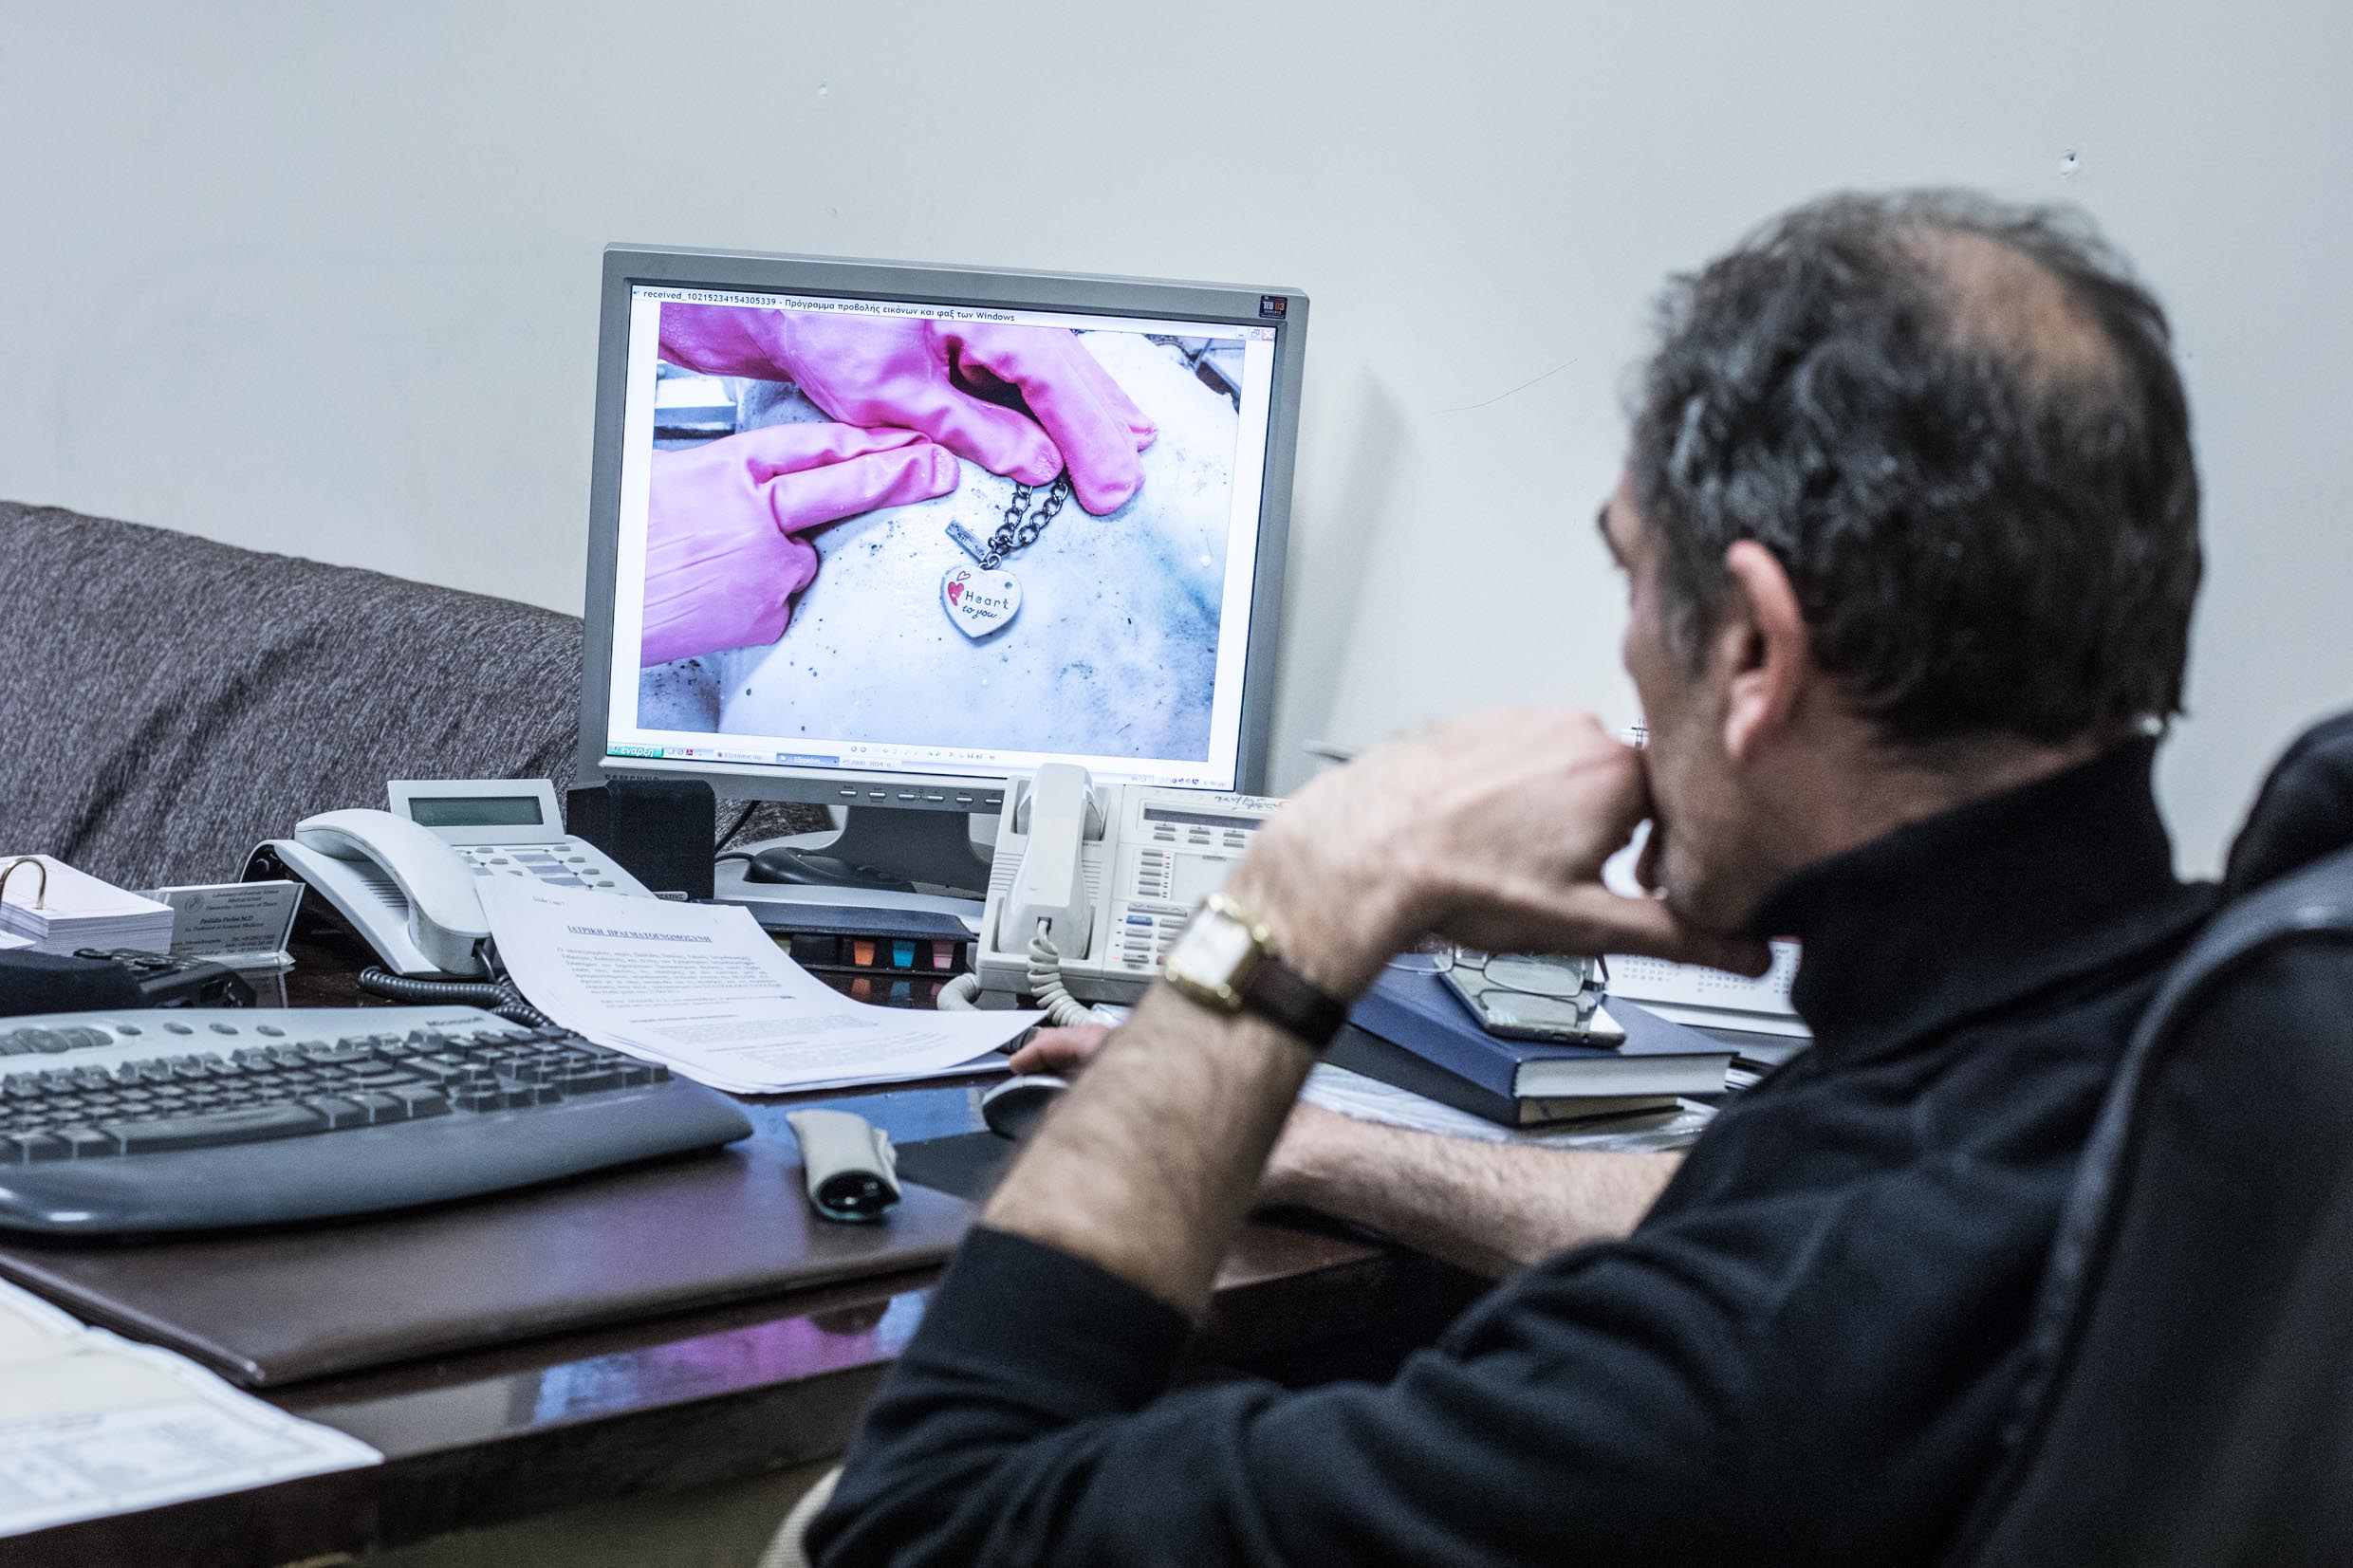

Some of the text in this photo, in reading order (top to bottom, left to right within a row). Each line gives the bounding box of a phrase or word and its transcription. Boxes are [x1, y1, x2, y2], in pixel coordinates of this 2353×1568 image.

[643, 290, 776, 305] received_10215234154305339
[785, 300, 835, 310] Πρόγραμμα
[838, 303, 880, 313] προβολής
[937, 309, 954, 319] φαξ
[976, 311, 1015, 322] Windows
[965, 590, 1009, 610] Heart
[962, 605, 974, 614] to
[621, 747, 654, 758] έναρξη
